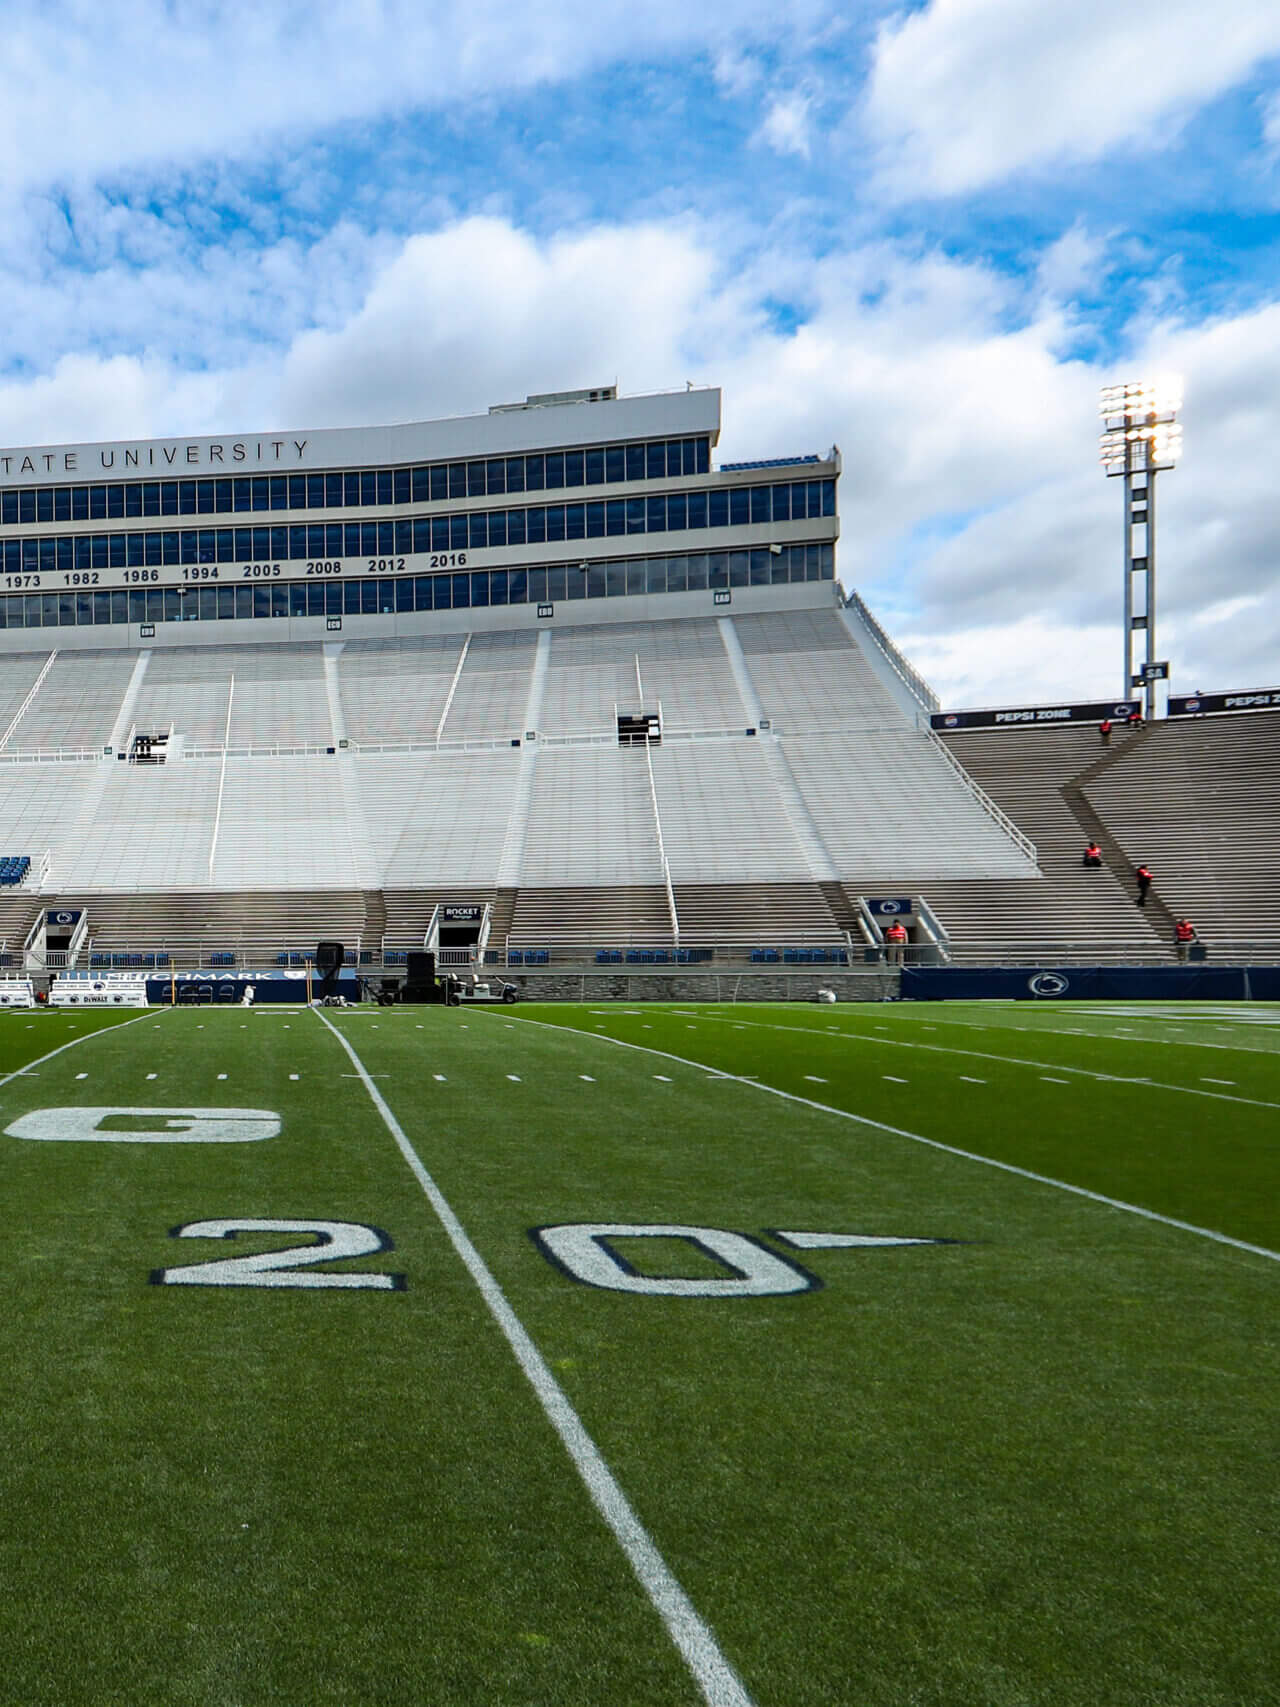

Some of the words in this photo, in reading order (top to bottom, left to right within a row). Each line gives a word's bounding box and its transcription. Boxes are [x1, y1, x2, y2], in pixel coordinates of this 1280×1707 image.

[100, 440, 310, 469] UNIVERSITY
[4, 575, 42, 588] 1973
[62, 572, 100, 585] 1982
[122, 569, 159, 583] 1986
[182, 566, 220, 580] 1994
[242, 564, 282, 578] 2005
[305, 561, 343, 575] 2008
[367, 558, 406, 572] 2012
[429, 553, 467, 568] 2016
[1146, 668, 1163, 679] SA
[1224, 695, 1270, 708] PEPSI
[995, 711, 1035, 722] PEPSI
[1036, 708, 1072, 720] ZONE
[446, 907, 478, 915] ROCKET
